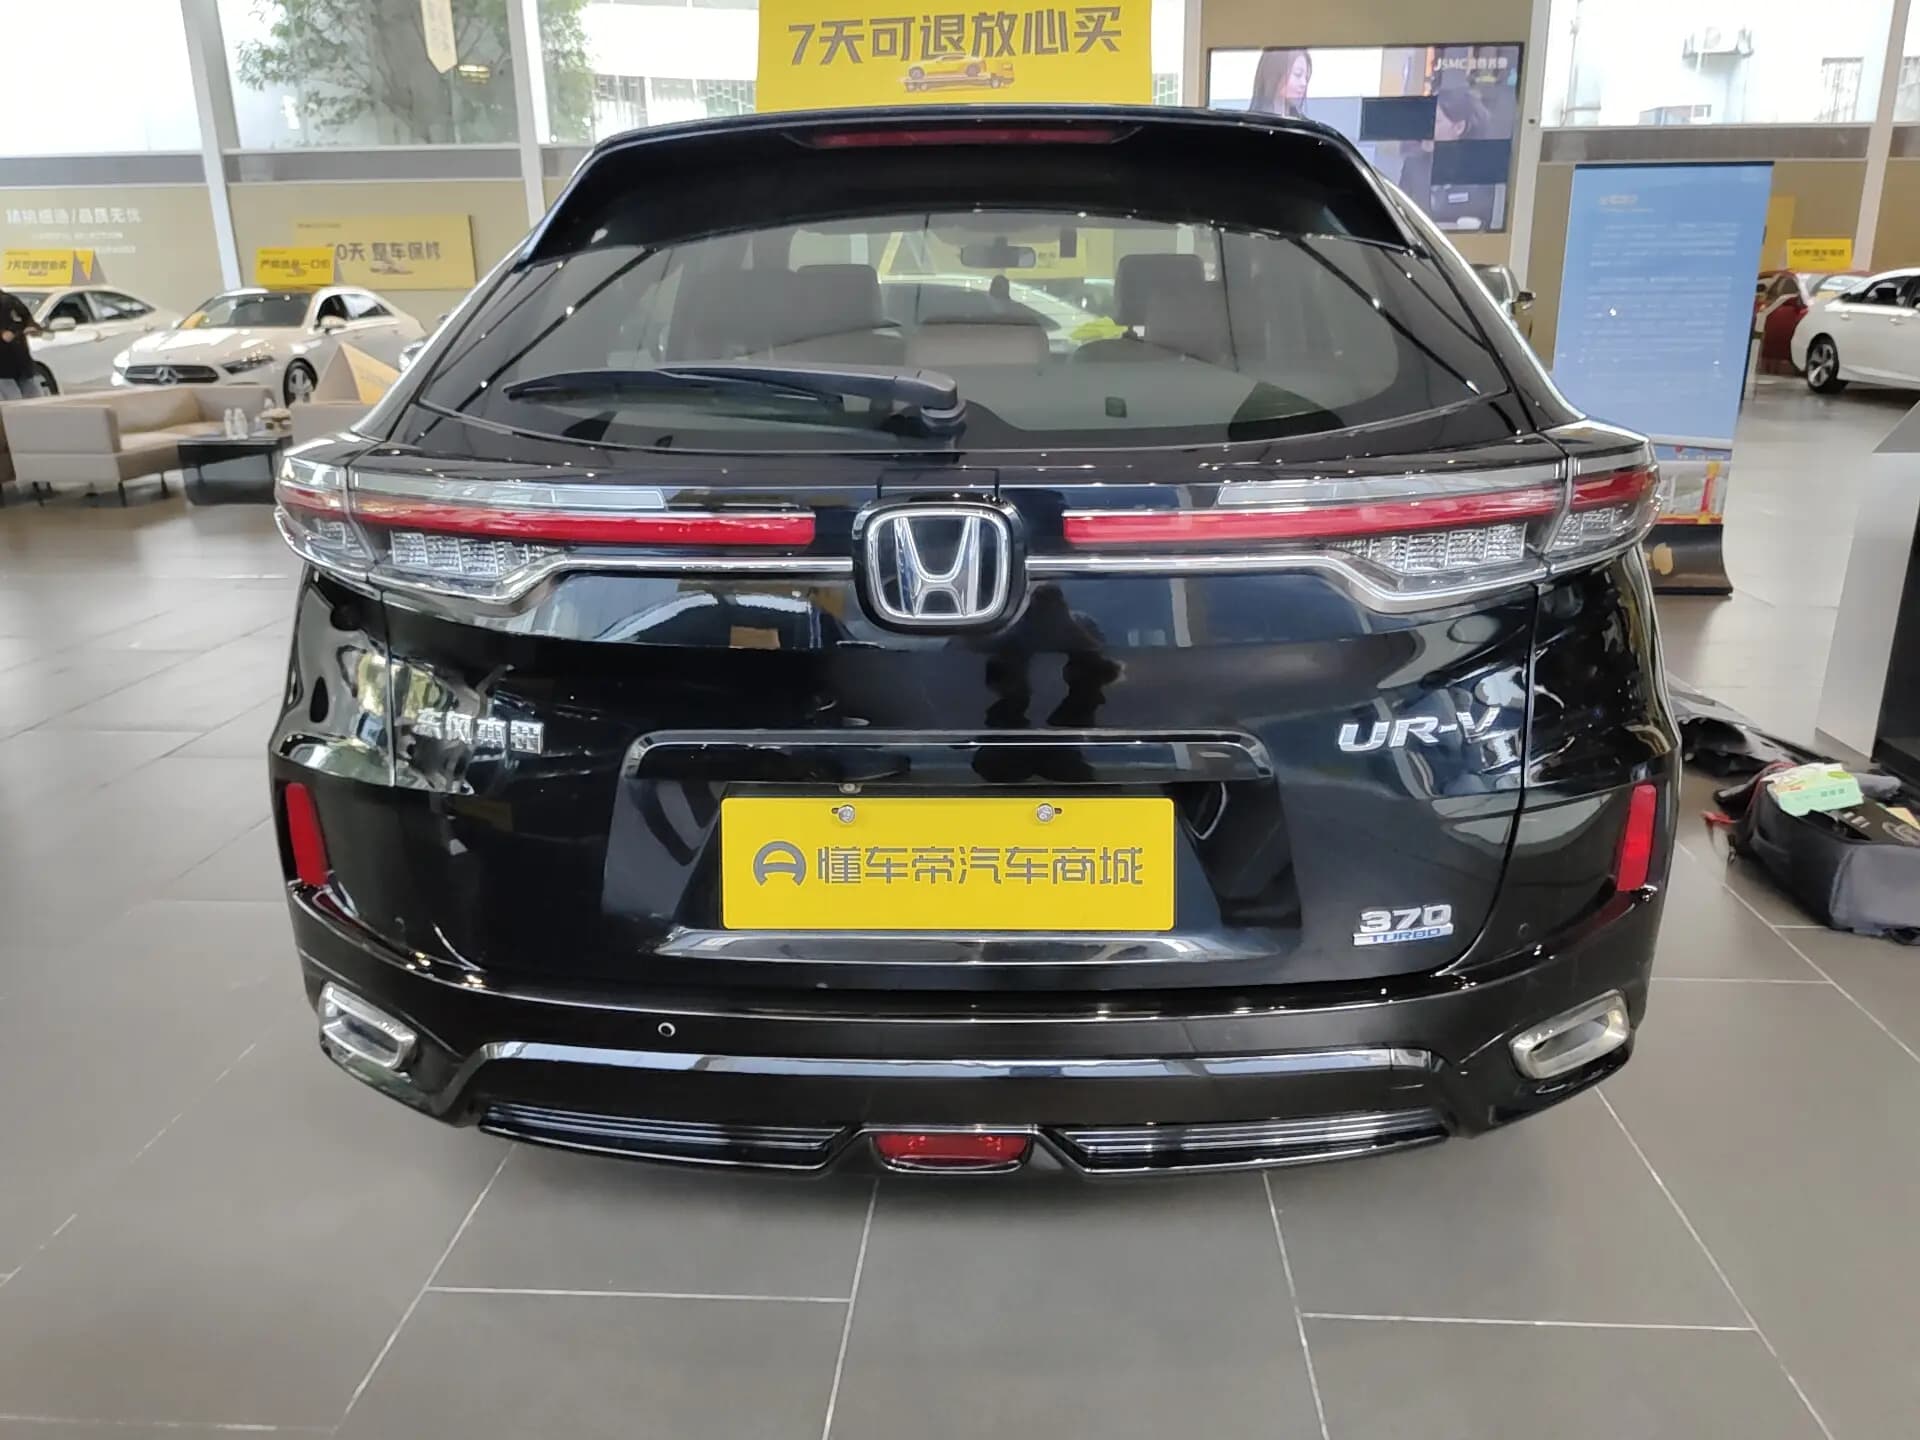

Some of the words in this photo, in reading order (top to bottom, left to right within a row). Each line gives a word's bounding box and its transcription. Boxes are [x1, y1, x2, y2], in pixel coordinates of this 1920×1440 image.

[788, 7, 1122, 65] 7天可退放心买
[1337, 707, 1501, 752] UR-V
[817, 846, 1144, 885] 懂车帝汽车商城
[1360, 904, 1452, 933] 370
[1368, 927, 1442, 944] TURBO
